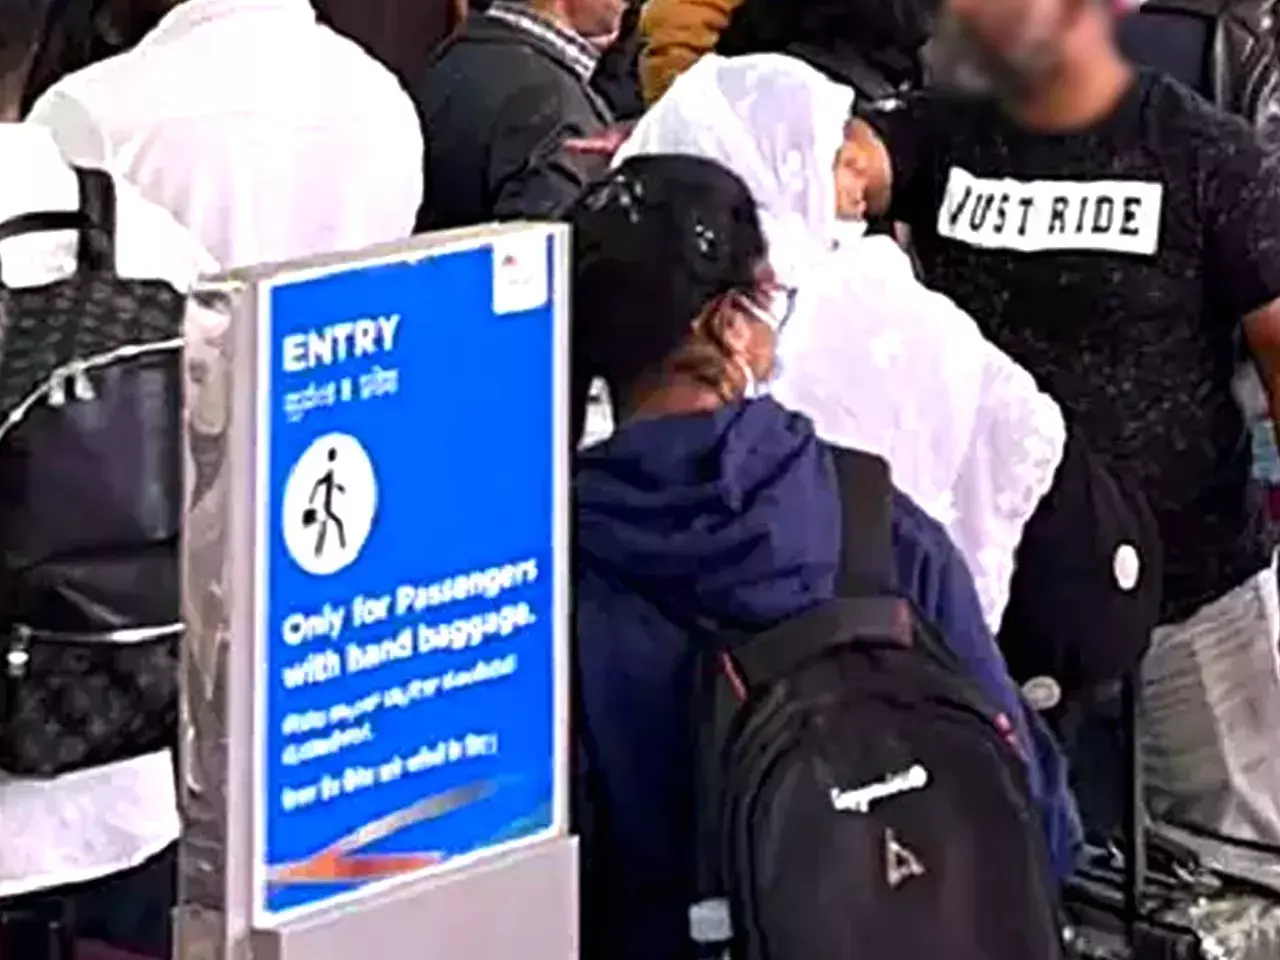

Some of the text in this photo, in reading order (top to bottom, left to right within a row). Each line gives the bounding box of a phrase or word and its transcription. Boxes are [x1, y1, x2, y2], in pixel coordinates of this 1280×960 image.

[1048, 194, 1142, 237] RIDE
[282, 312, 401, 372] ENTRY
[282, 558, 538, 646] Only for Passengers
[281, 649, 341, 689] with
[345, 627, 413, 674] hand
[417, 602, 537, 654] baggage.
